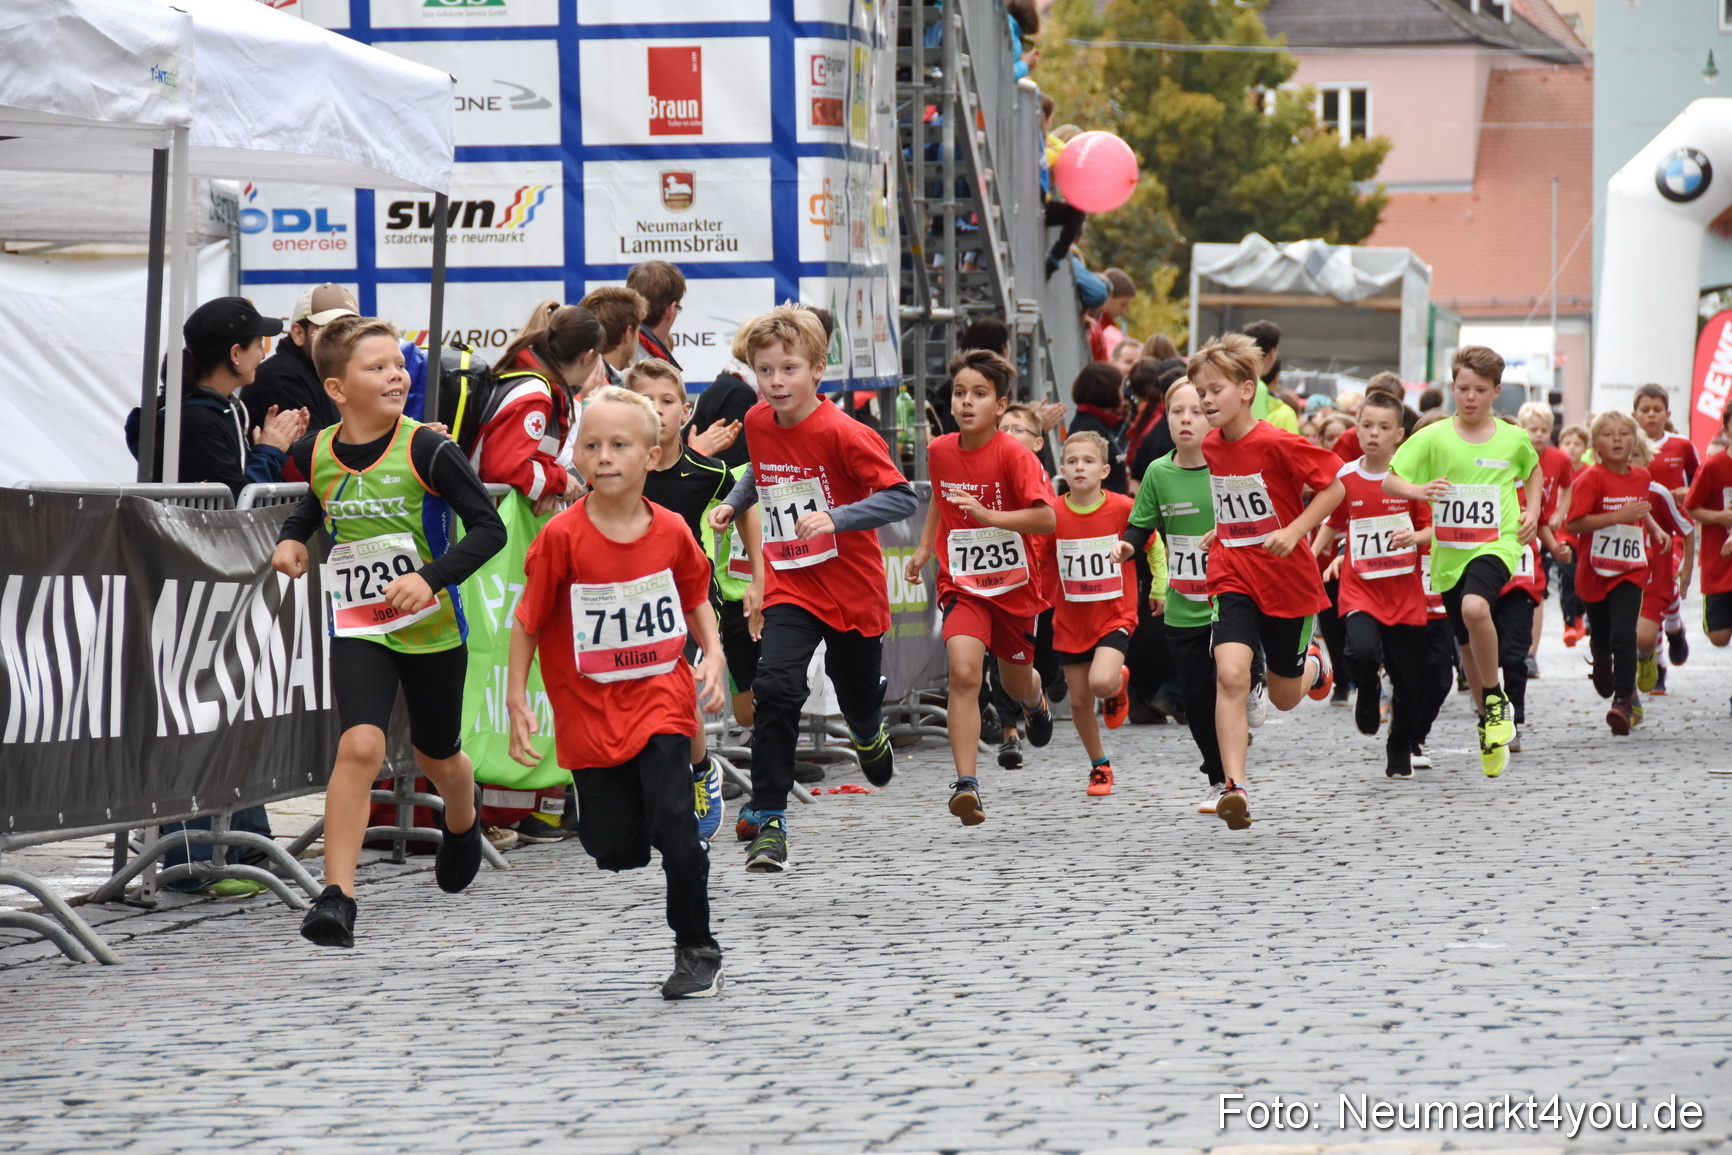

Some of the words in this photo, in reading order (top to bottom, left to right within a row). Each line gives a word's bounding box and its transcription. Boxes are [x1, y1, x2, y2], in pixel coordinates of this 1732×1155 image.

[648, 95, 699, 119] Braun
[384, 232, 458, 244] stadtweke
[461, 231, 526, 244] neumarkt
[636, 219, 724, 233] Neumarkter
[272, 233, 348, 251] energie
[620, 233, 739, 254] Lammsbräu
[326, 496, 410, 520] BOCK
[1438, 500, 1495, 525] 7043
[1356, 527, 1409, 556] 712
[1599, 535, 1640, 560] 7166
[954, 540, 1019, 572] 7235
[1063, 551, 1116, 577] 7101
[623, 574, 671, 598] BOCK
[882, 554, 928, 605] OCK
[585, 595, 676, 645] 7146
[0, 575, 127, 744] MINI
[614, 650, 658, 668] Kilian
